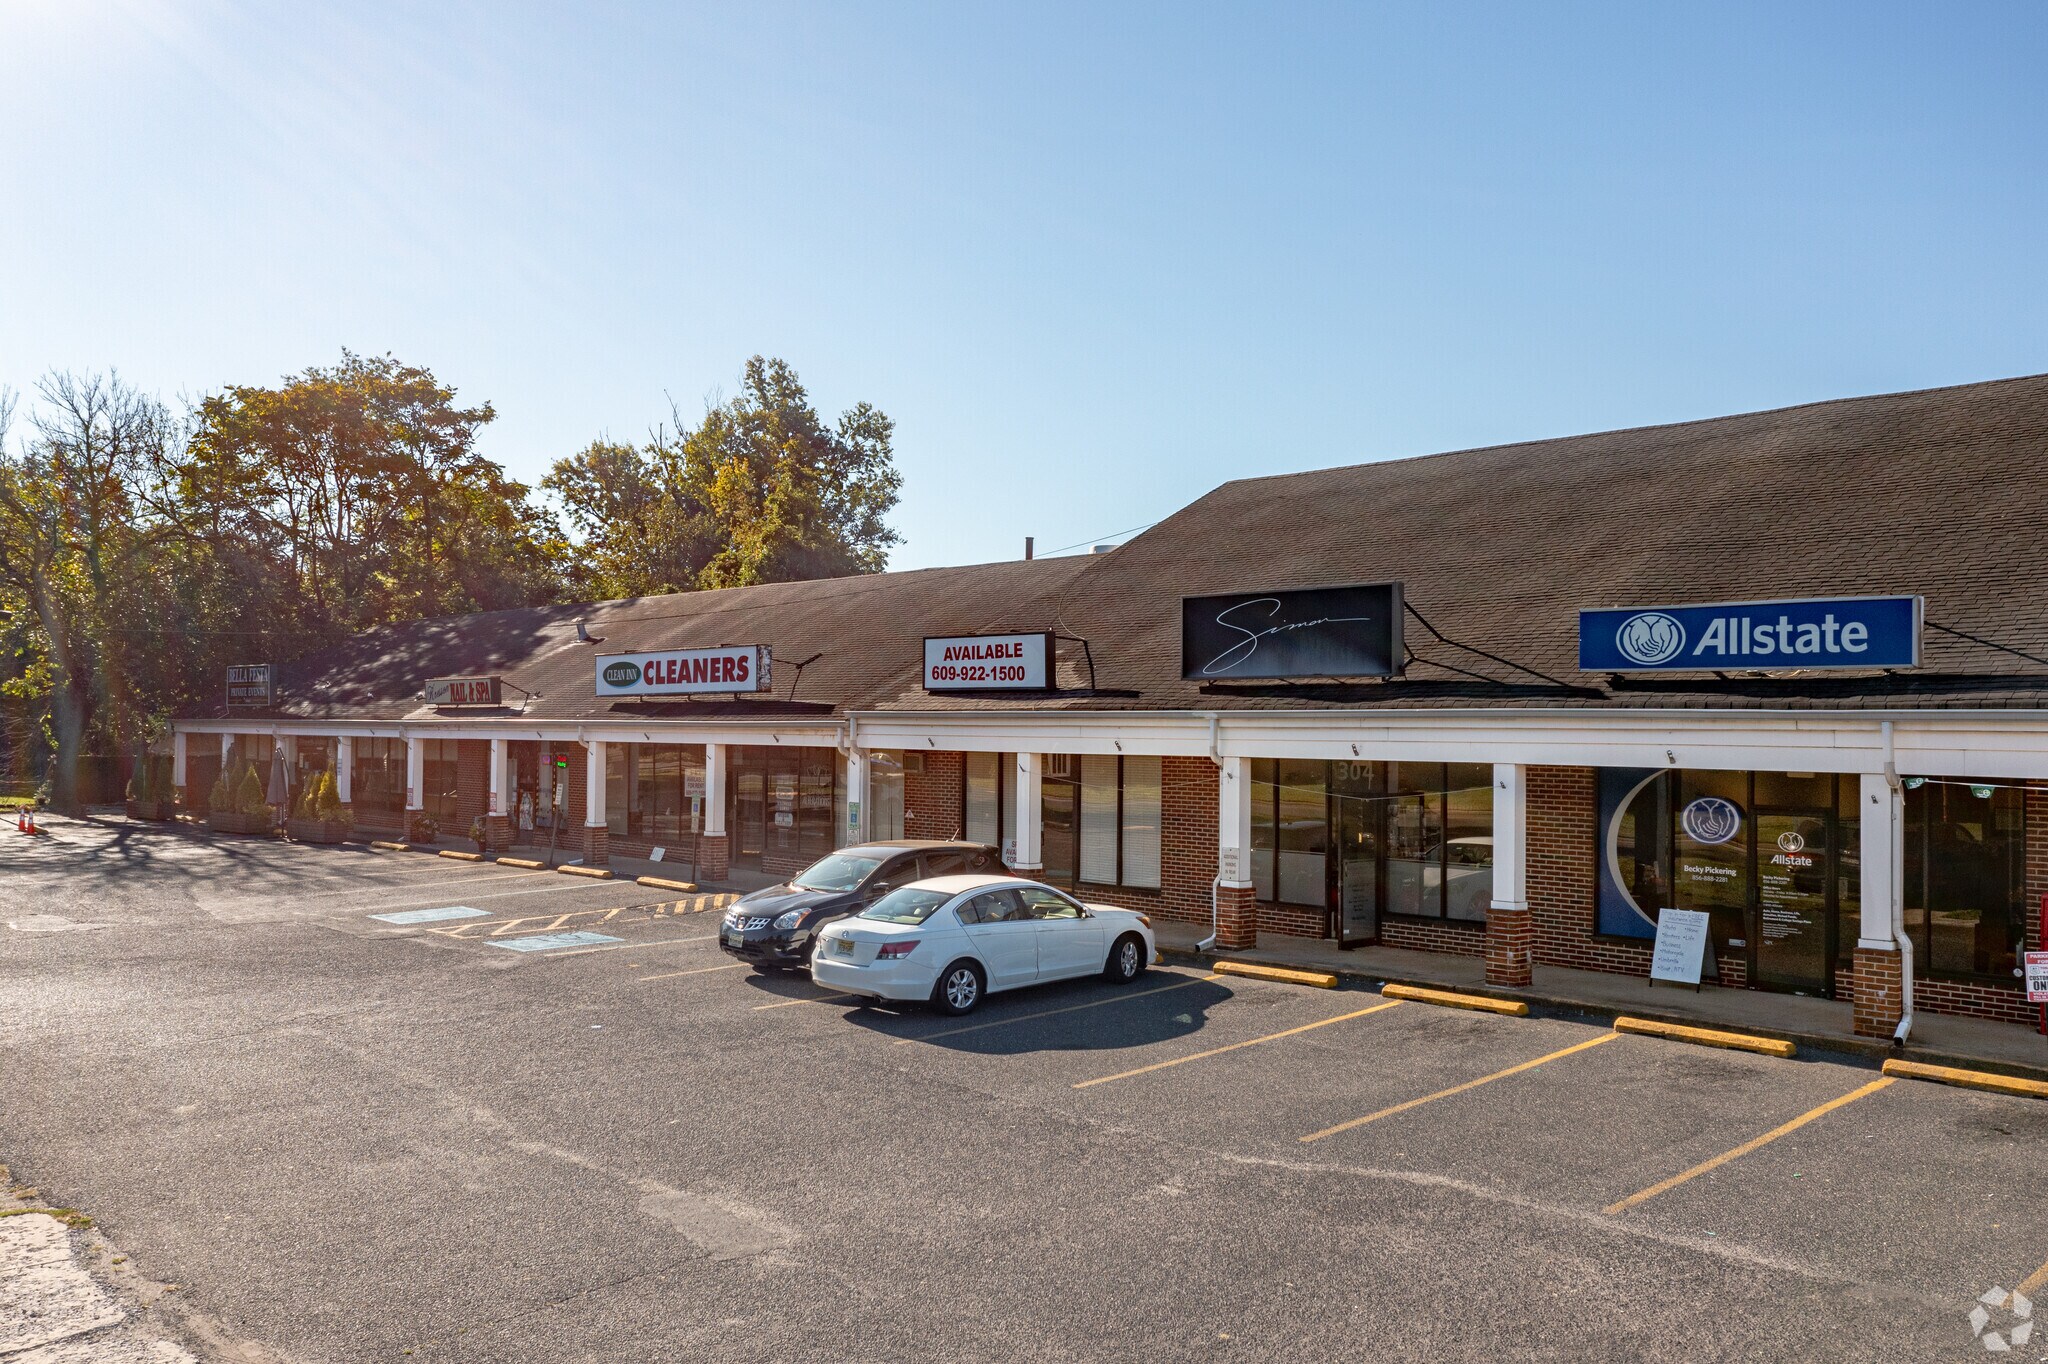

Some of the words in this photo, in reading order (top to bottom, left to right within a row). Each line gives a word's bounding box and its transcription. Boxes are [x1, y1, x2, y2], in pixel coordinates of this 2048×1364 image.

[1692, 614, 1868, 656] Allstate
[943, 642, 1023, 661] AVAILABLE
[606, 669, 625, 681] CLEAN
[626, 668, 637, 680] INN
[643, 655, 749, 686] CLEANERS
[931, 665, 1025, 681] 609-922-1500
[450, 683, 468, 703] NAIL
[468, 682, 475, 703] &
[475, 681, 491, 703] SPA
[1337, 761, 1375, 781] 304
[1770, 854, 1812, 867] Allstate
[1683, 864, 1704, 875] Becky
[1705, 866, 1737, 877] Pickering
[2033, 980, 2048, 991] ON
